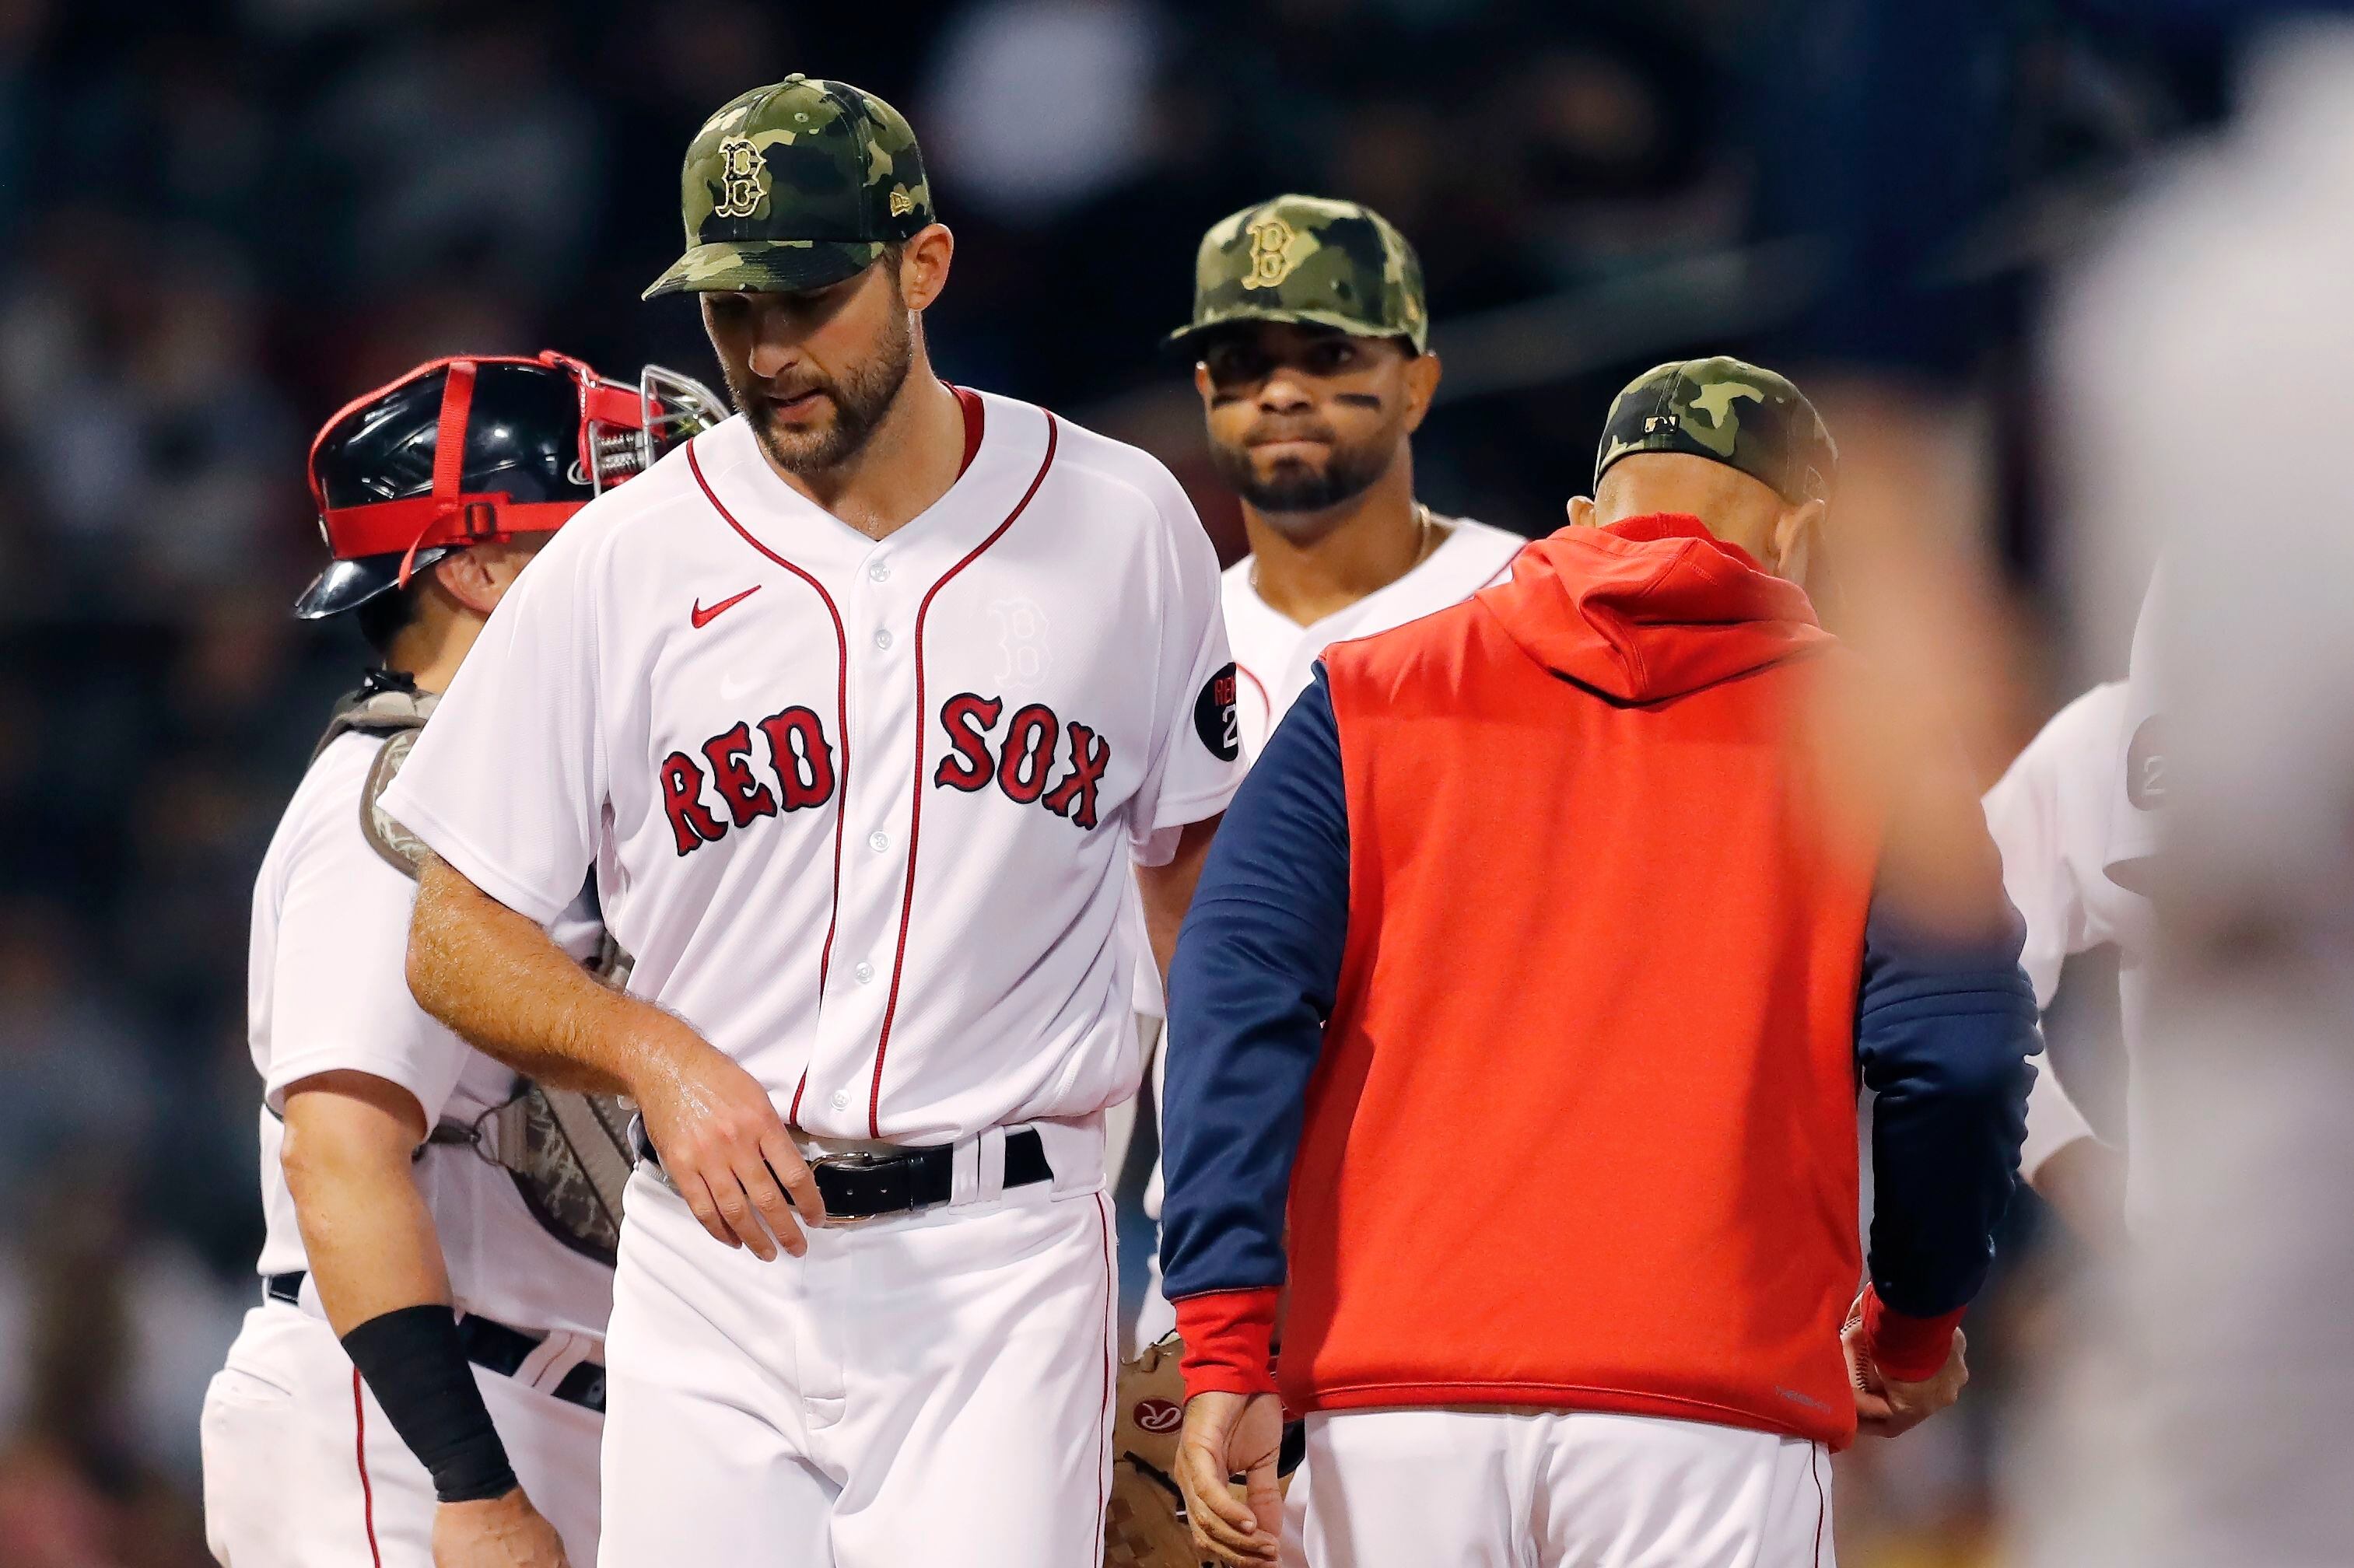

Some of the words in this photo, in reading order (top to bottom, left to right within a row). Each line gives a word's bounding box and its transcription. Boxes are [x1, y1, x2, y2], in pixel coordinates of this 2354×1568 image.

[715, 137, 767, 218] B
[1241, 219, 1295, 290] B
[987, 597, 1053, 688] B
[660, 705, 835, 857] RED
[935, 692, 1111, 831] SOX
[2143, 754, 2166, 796] 2
